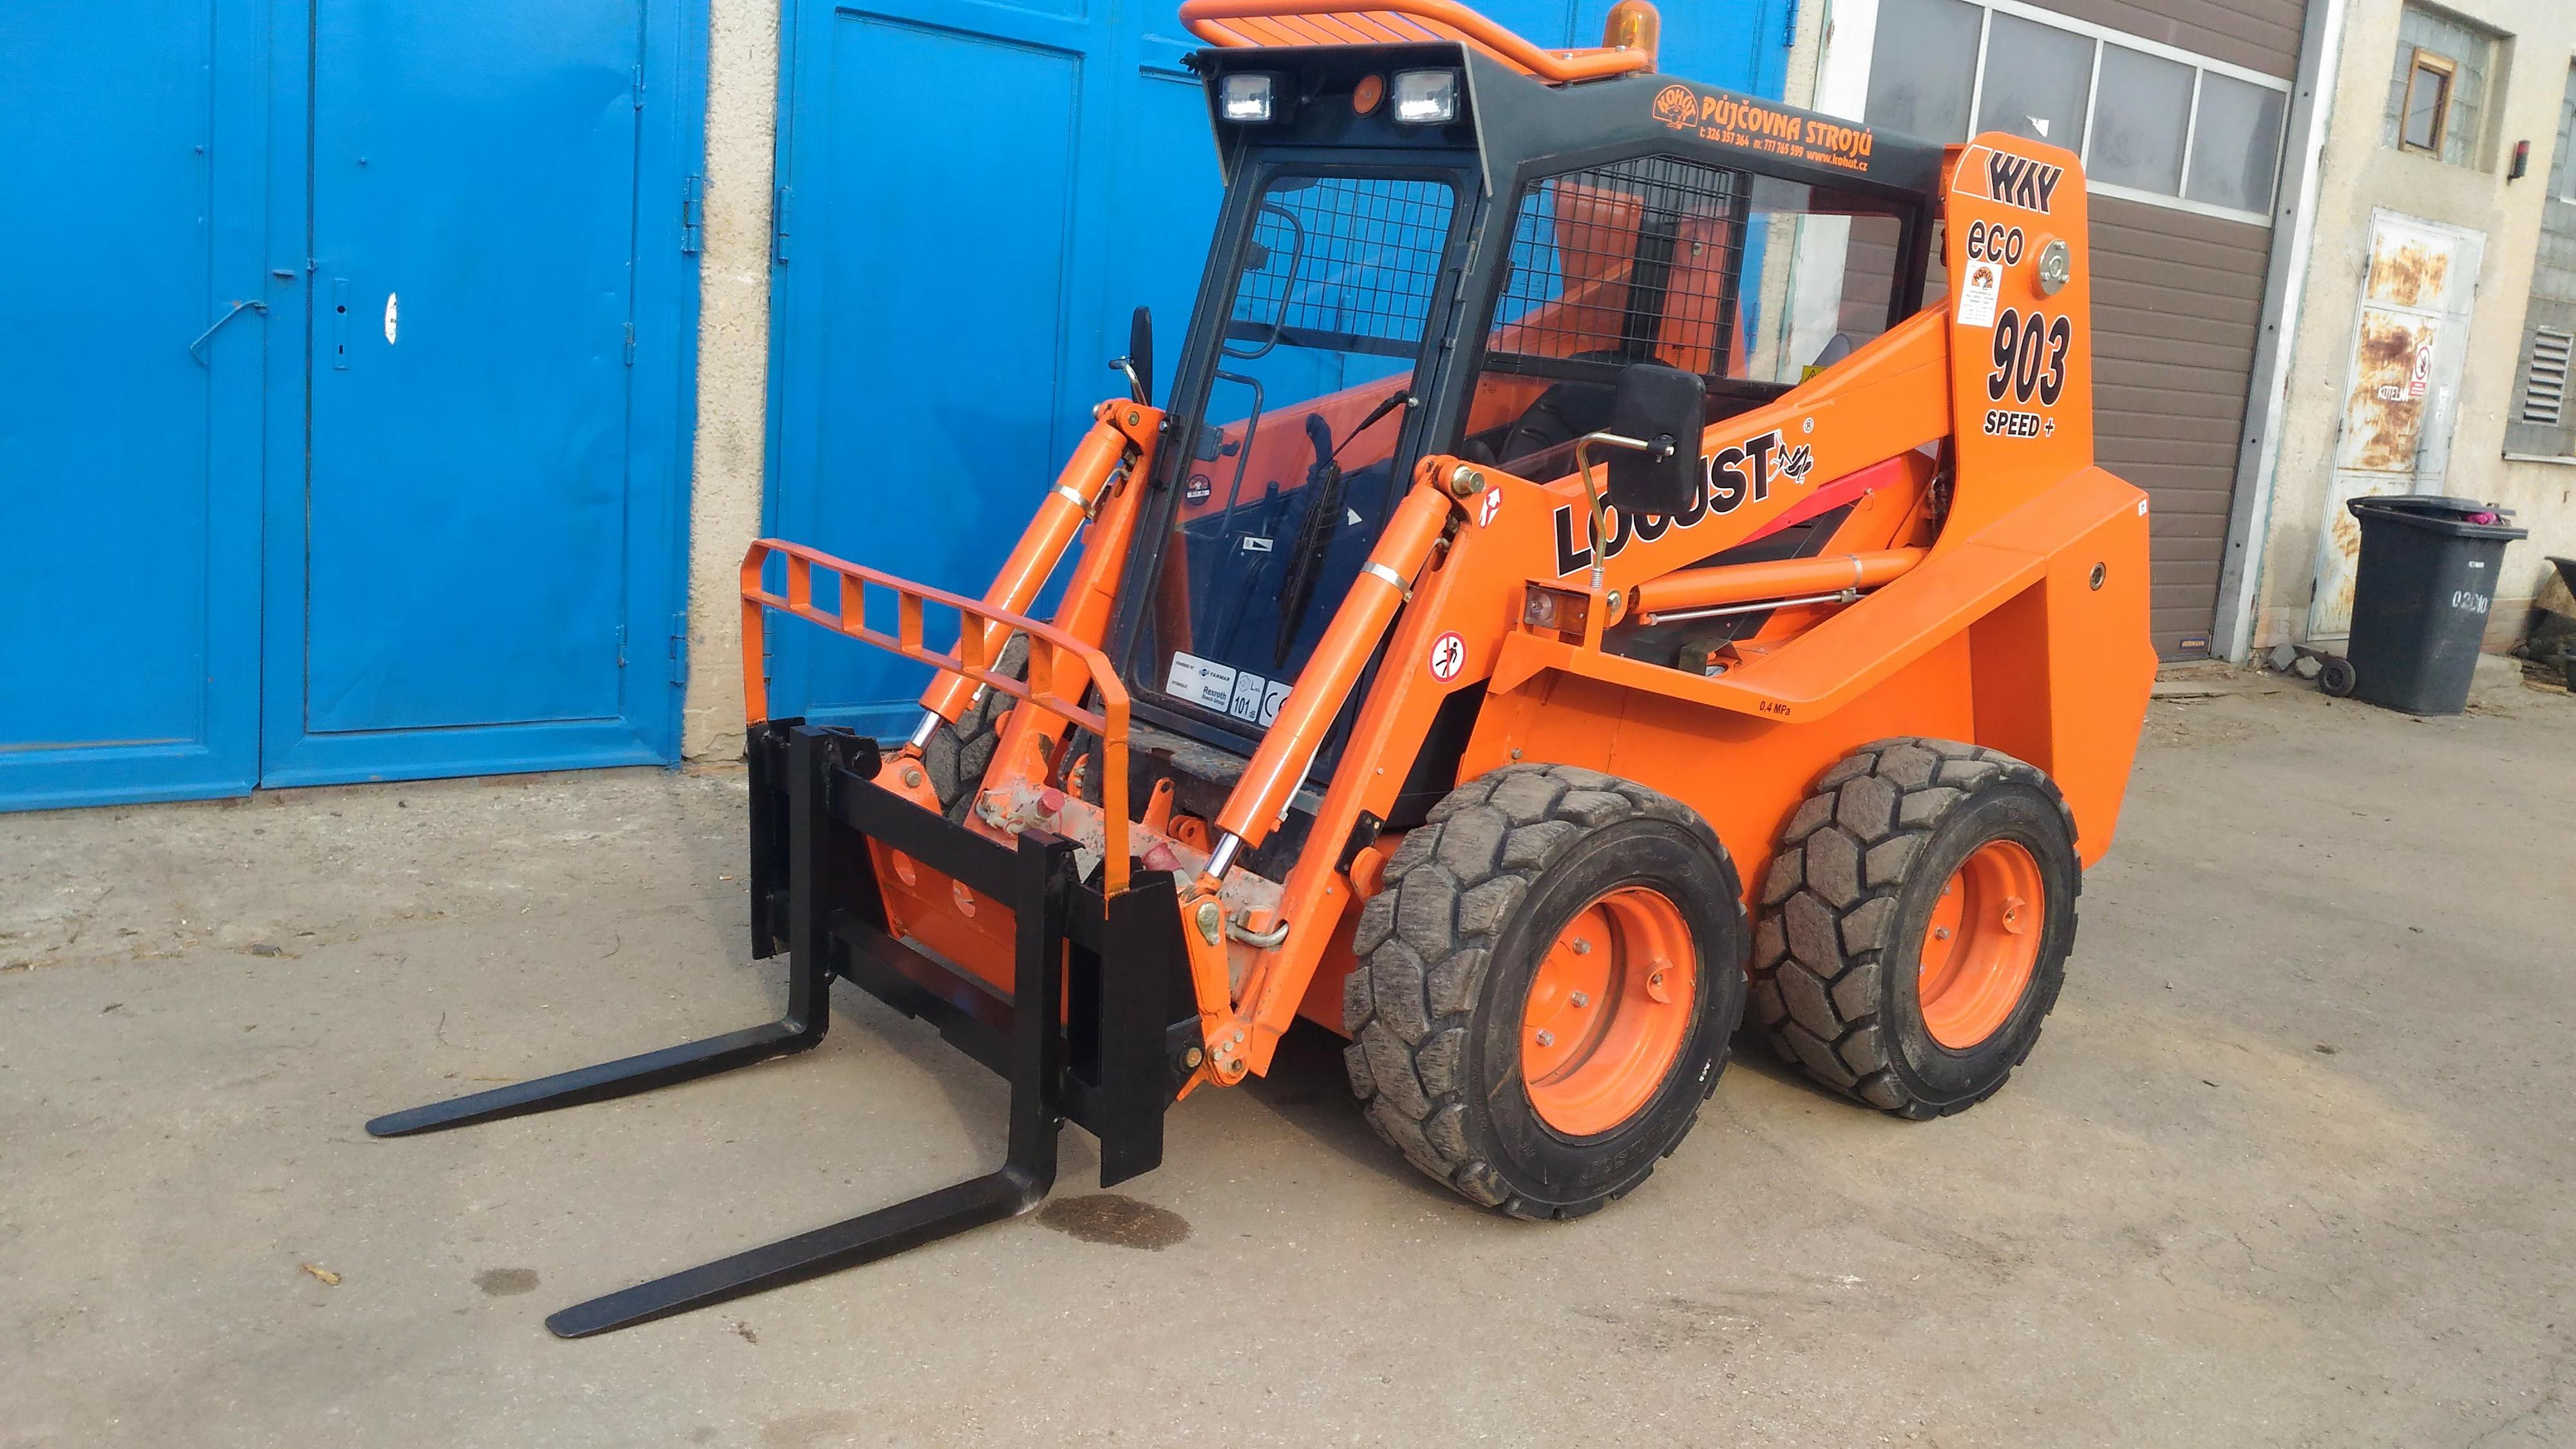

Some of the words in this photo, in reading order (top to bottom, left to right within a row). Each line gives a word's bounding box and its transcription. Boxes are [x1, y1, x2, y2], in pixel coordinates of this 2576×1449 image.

[1701, 94, 1802, 141] PŮJČOVNA
[1806, 120, 1873, 157] STROJŮ
[1700, 127, 1705, 138] t:
[1707, 128, 1720, 141] 326
[1721, 130, 1735, 144] 357
[1736, 134, 1750, 147] 364
[1764, 138, 1776, 153] 777
[1777, 141, 1789, 155] 765
[1790, 144, 1804, 158] 599
[1806, 150, 1869, 171] www.kohut.cz
[1989, 149, 2064, 214] WAY
[1967, 220, 2025, 267] eco
[1987, 307, 2072, 408] 903
[2377, 385, 2409, 402] KOTELNA
[1984, 410, 2041, 437] SPEED
[1203, 685, 1227, 701] Rexroth
[1234, 696, 1251, 715] 101
[1774, 703, 1791, 716] MPa
